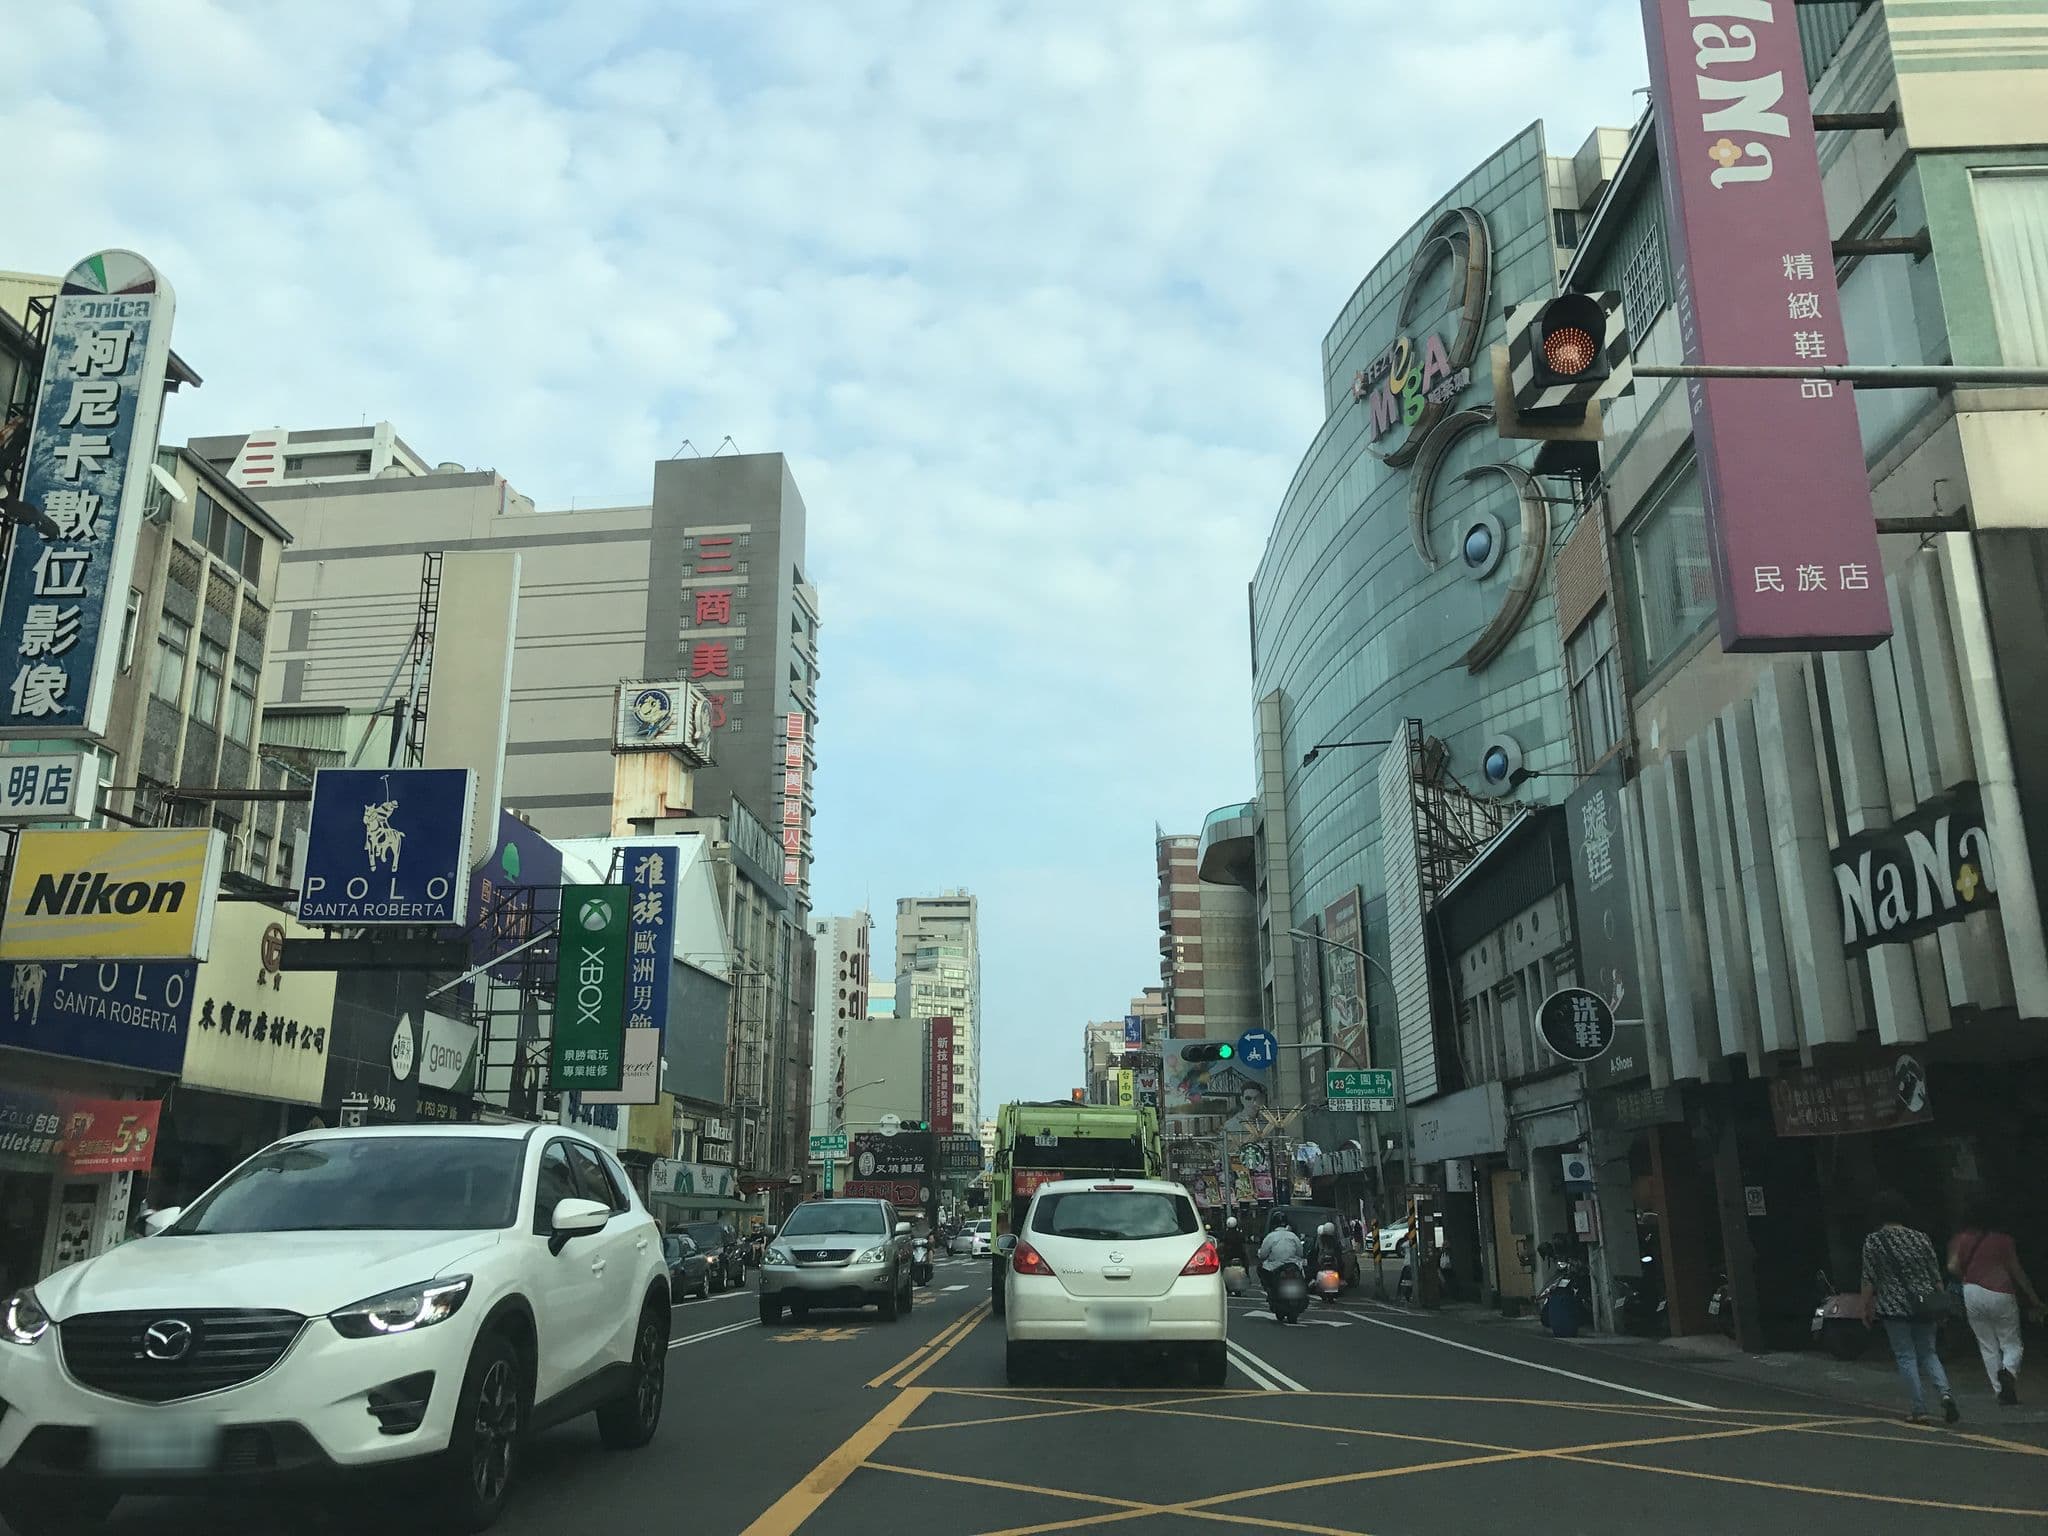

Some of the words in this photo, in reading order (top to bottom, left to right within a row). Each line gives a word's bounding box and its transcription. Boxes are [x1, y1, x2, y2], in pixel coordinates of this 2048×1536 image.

[1782, 253, 1834, 400] 精緻鞋品
[8, 328, 135, 718] 柯尼卡數位影像
[1752, 562, 1872, 593] 民族店
[0, 764, 73, 807] 明店
[25, 871, 186, 916] Nikon
[306, 877, 449, 901] POLO
[1833, 815, 1998, 945] NaNa
[303, 903, 360, 917] SANTA
[363, 903, 445, 917] ROBERTA
[577, 946, 606, 1025] XBOX
[54, 988, 107, 1020] SANTA
[111, 1002, 178, 1034] ROBERTA
[1571, 996, 1603, 1048] 洗鞋
[429, 1042, 463, 1073] game
[1334, 1079, 1345, 1090] 23
[1345, 1073, 1386, 1086] 公園路
[373, 1094, 397, 1114] 9936
